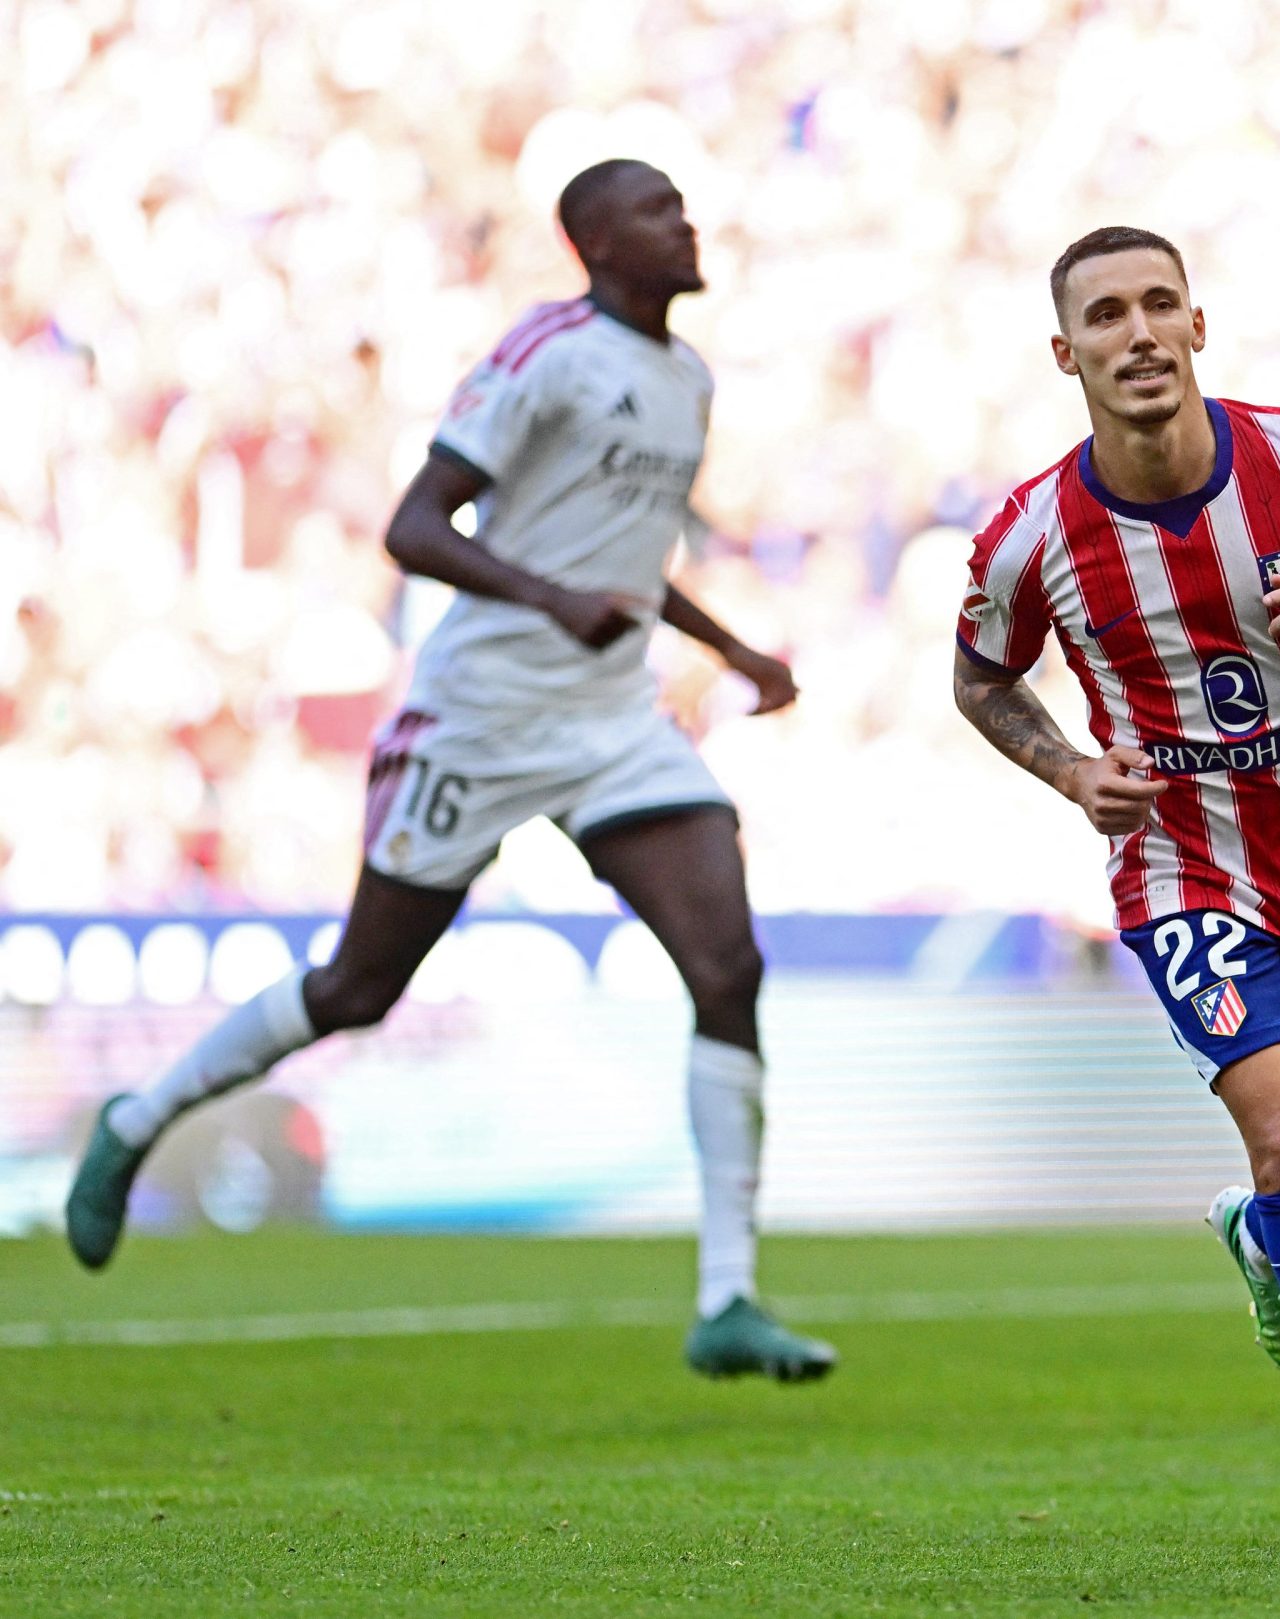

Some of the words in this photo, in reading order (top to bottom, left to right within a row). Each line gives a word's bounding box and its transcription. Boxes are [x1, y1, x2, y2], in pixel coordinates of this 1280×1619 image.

[1152, 736, 1278, 770] RIYADH
[404, 755, 468, 839] 16
[1153, 911, 1247, 1002] 22
